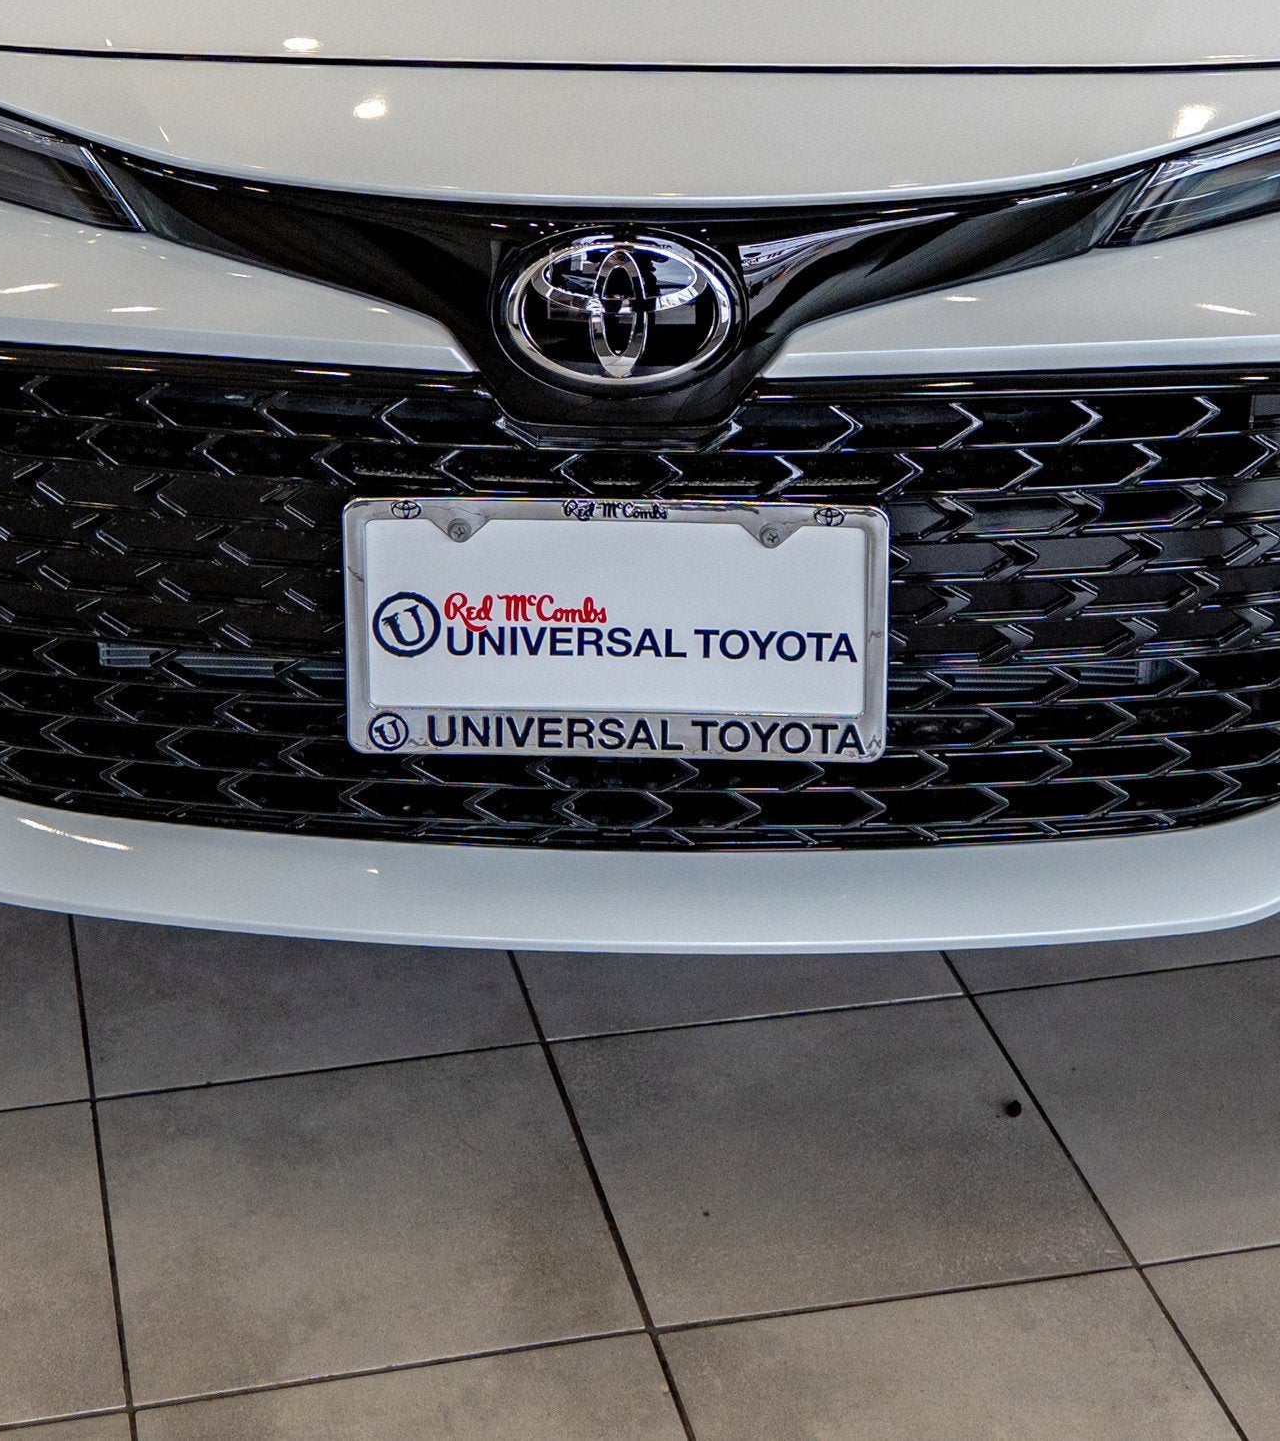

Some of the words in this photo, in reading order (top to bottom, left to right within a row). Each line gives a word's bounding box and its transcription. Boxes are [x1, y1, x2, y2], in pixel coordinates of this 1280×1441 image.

[562, 499, 595, 521] Red
[597, 501, 669, 520] McCombs
[444, 592, 493, 632] Red
[497, 594, 607, 623] McCombs
[447, 626, 686, 659] UNIVERSAL
[694, 629, 858, 663] TOYOTA
[427, 715, 683, 751] UNIVERSAL
[691, 720, 866, 755] TOYOTA
